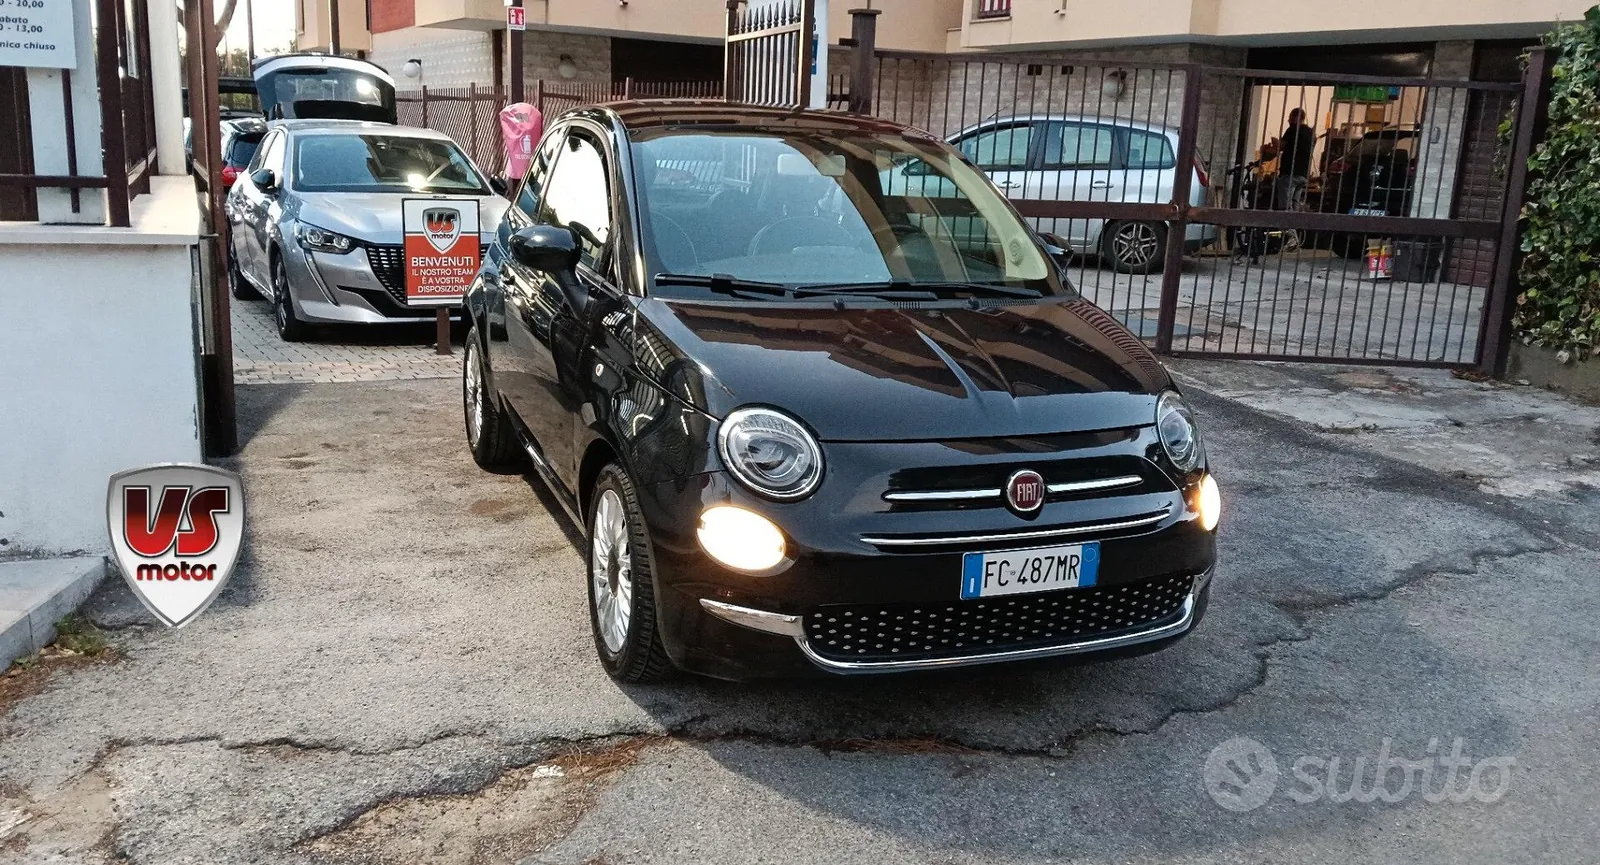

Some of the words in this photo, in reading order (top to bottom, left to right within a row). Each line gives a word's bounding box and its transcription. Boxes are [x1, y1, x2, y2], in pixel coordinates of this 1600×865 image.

[16, 24, 43, 34] 13,00
[23, 42, 56, 51] chiuso
[411, 256, 474, 267] BENVENUTI
[420, 268, 452, 276] NOSTRO
[1016, 482, 1038, 502] FIAT
